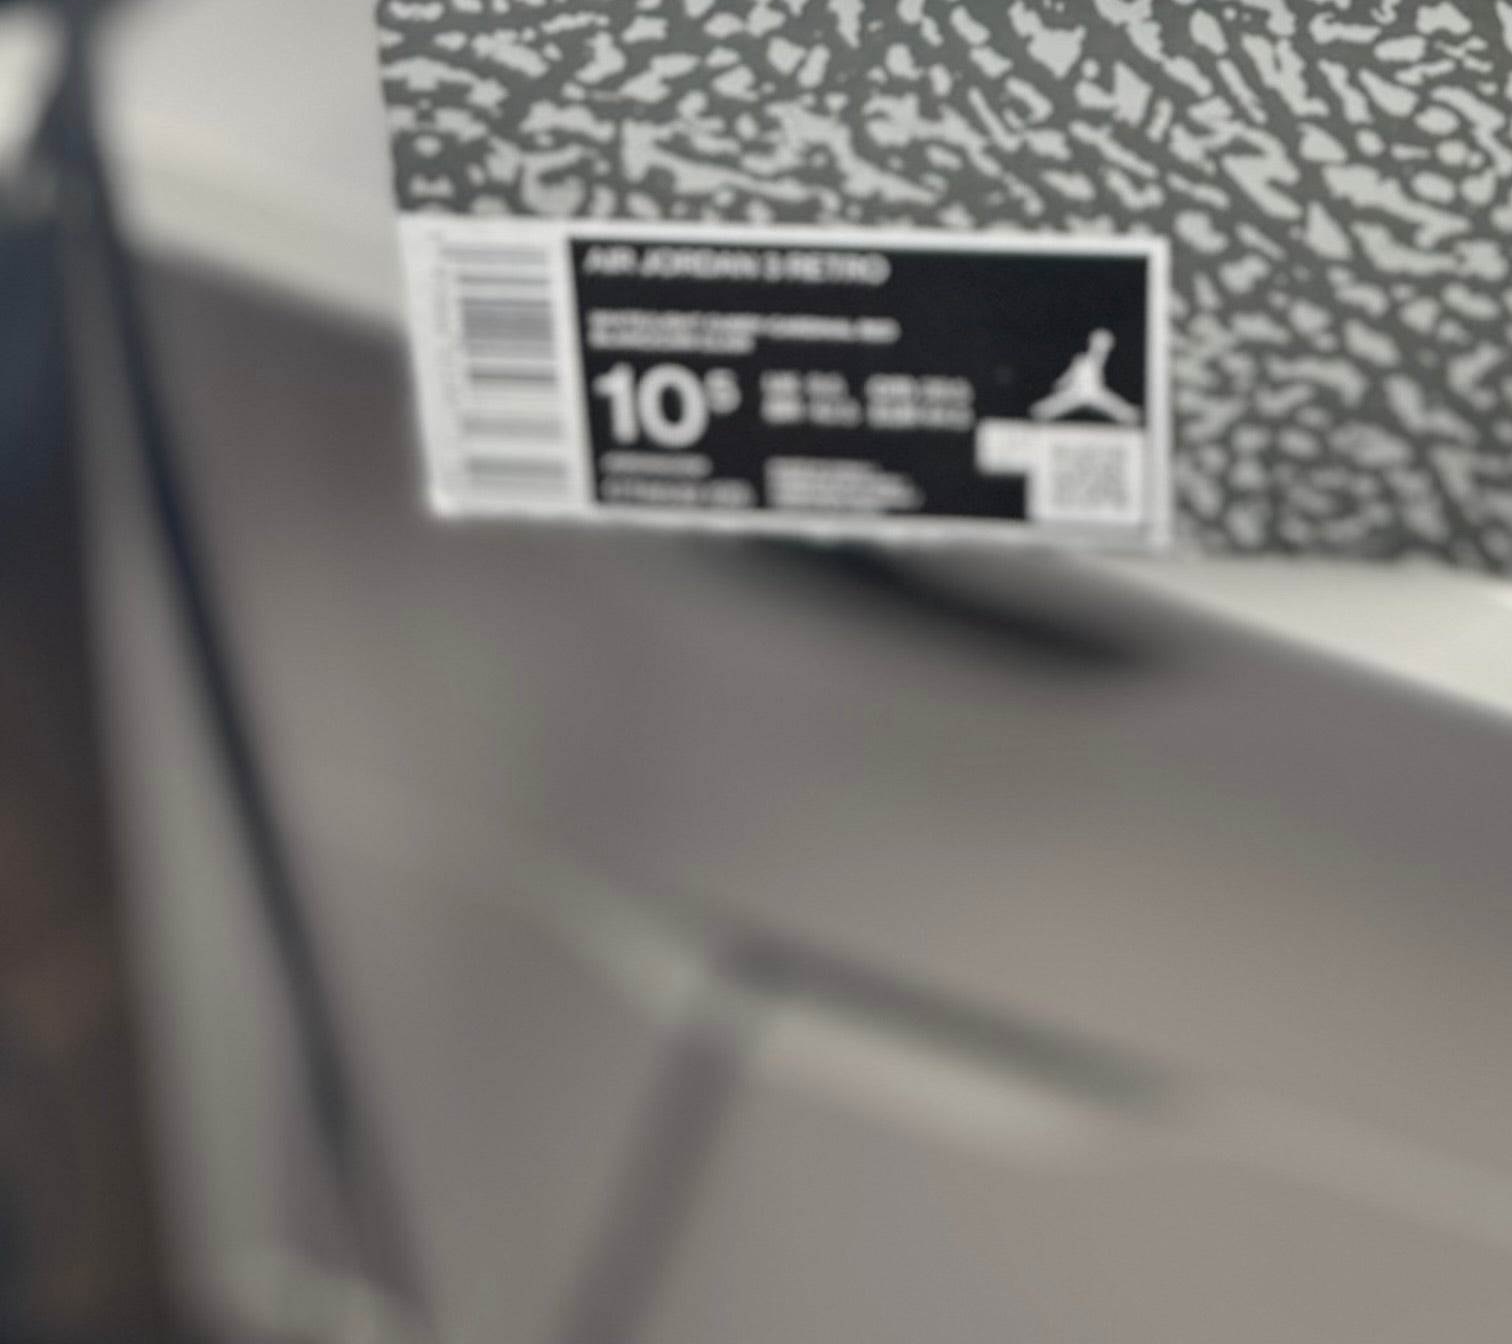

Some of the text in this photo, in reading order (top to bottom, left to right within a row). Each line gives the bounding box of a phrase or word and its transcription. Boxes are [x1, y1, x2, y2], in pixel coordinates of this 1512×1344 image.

[583, 245, 638, 276] AIR
[640, 246, 760, 280] JORDAN
[785, 250, 892, 286] RETRO
